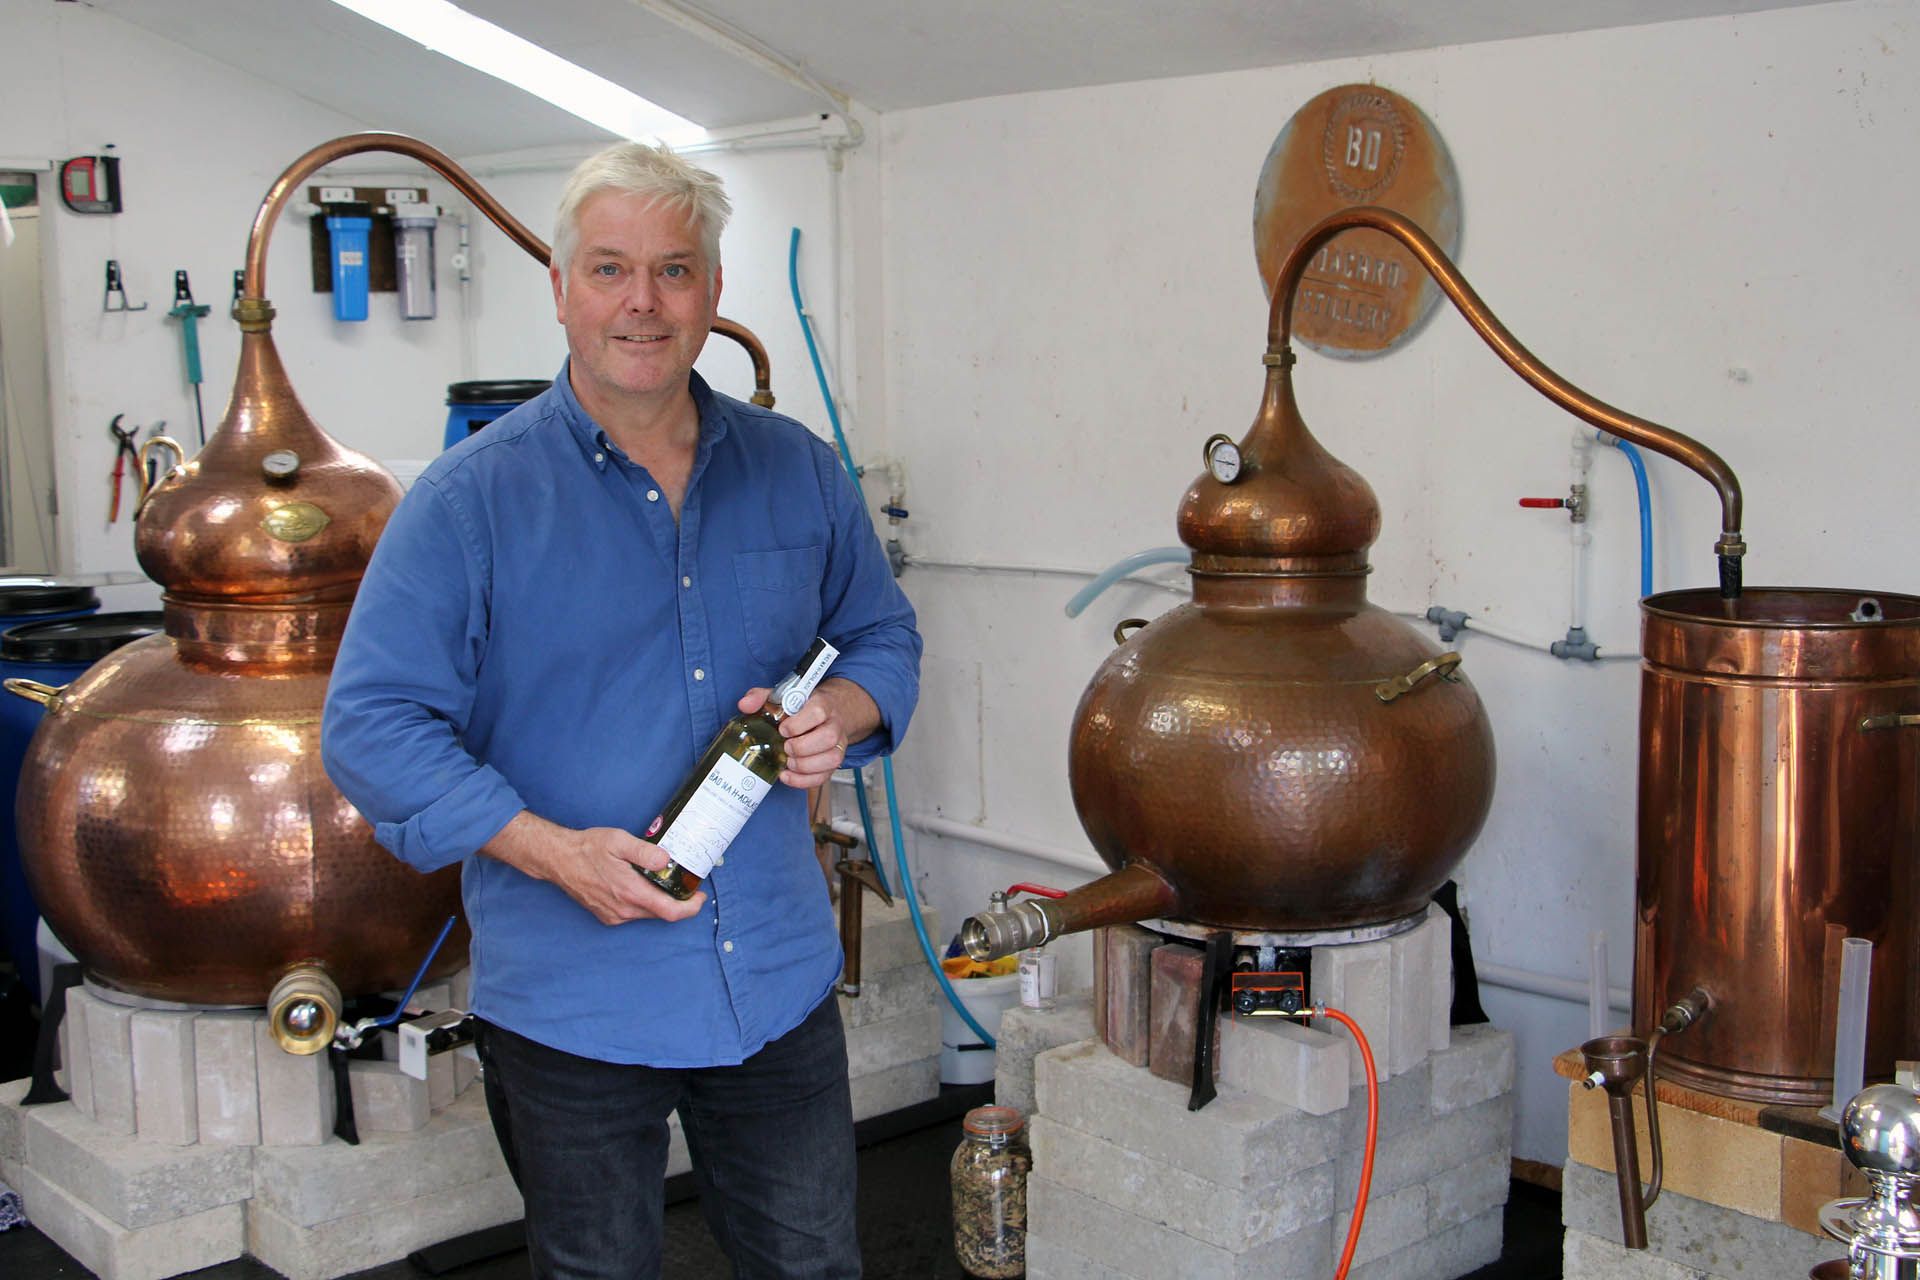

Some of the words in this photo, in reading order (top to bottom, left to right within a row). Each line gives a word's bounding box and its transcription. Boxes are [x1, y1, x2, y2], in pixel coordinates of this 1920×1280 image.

[1345, 125, 1382, 171] BD
[1308, 247, 1400, 289] DACHRO
[1295, 286, 1392, 332] ISTILLERY
